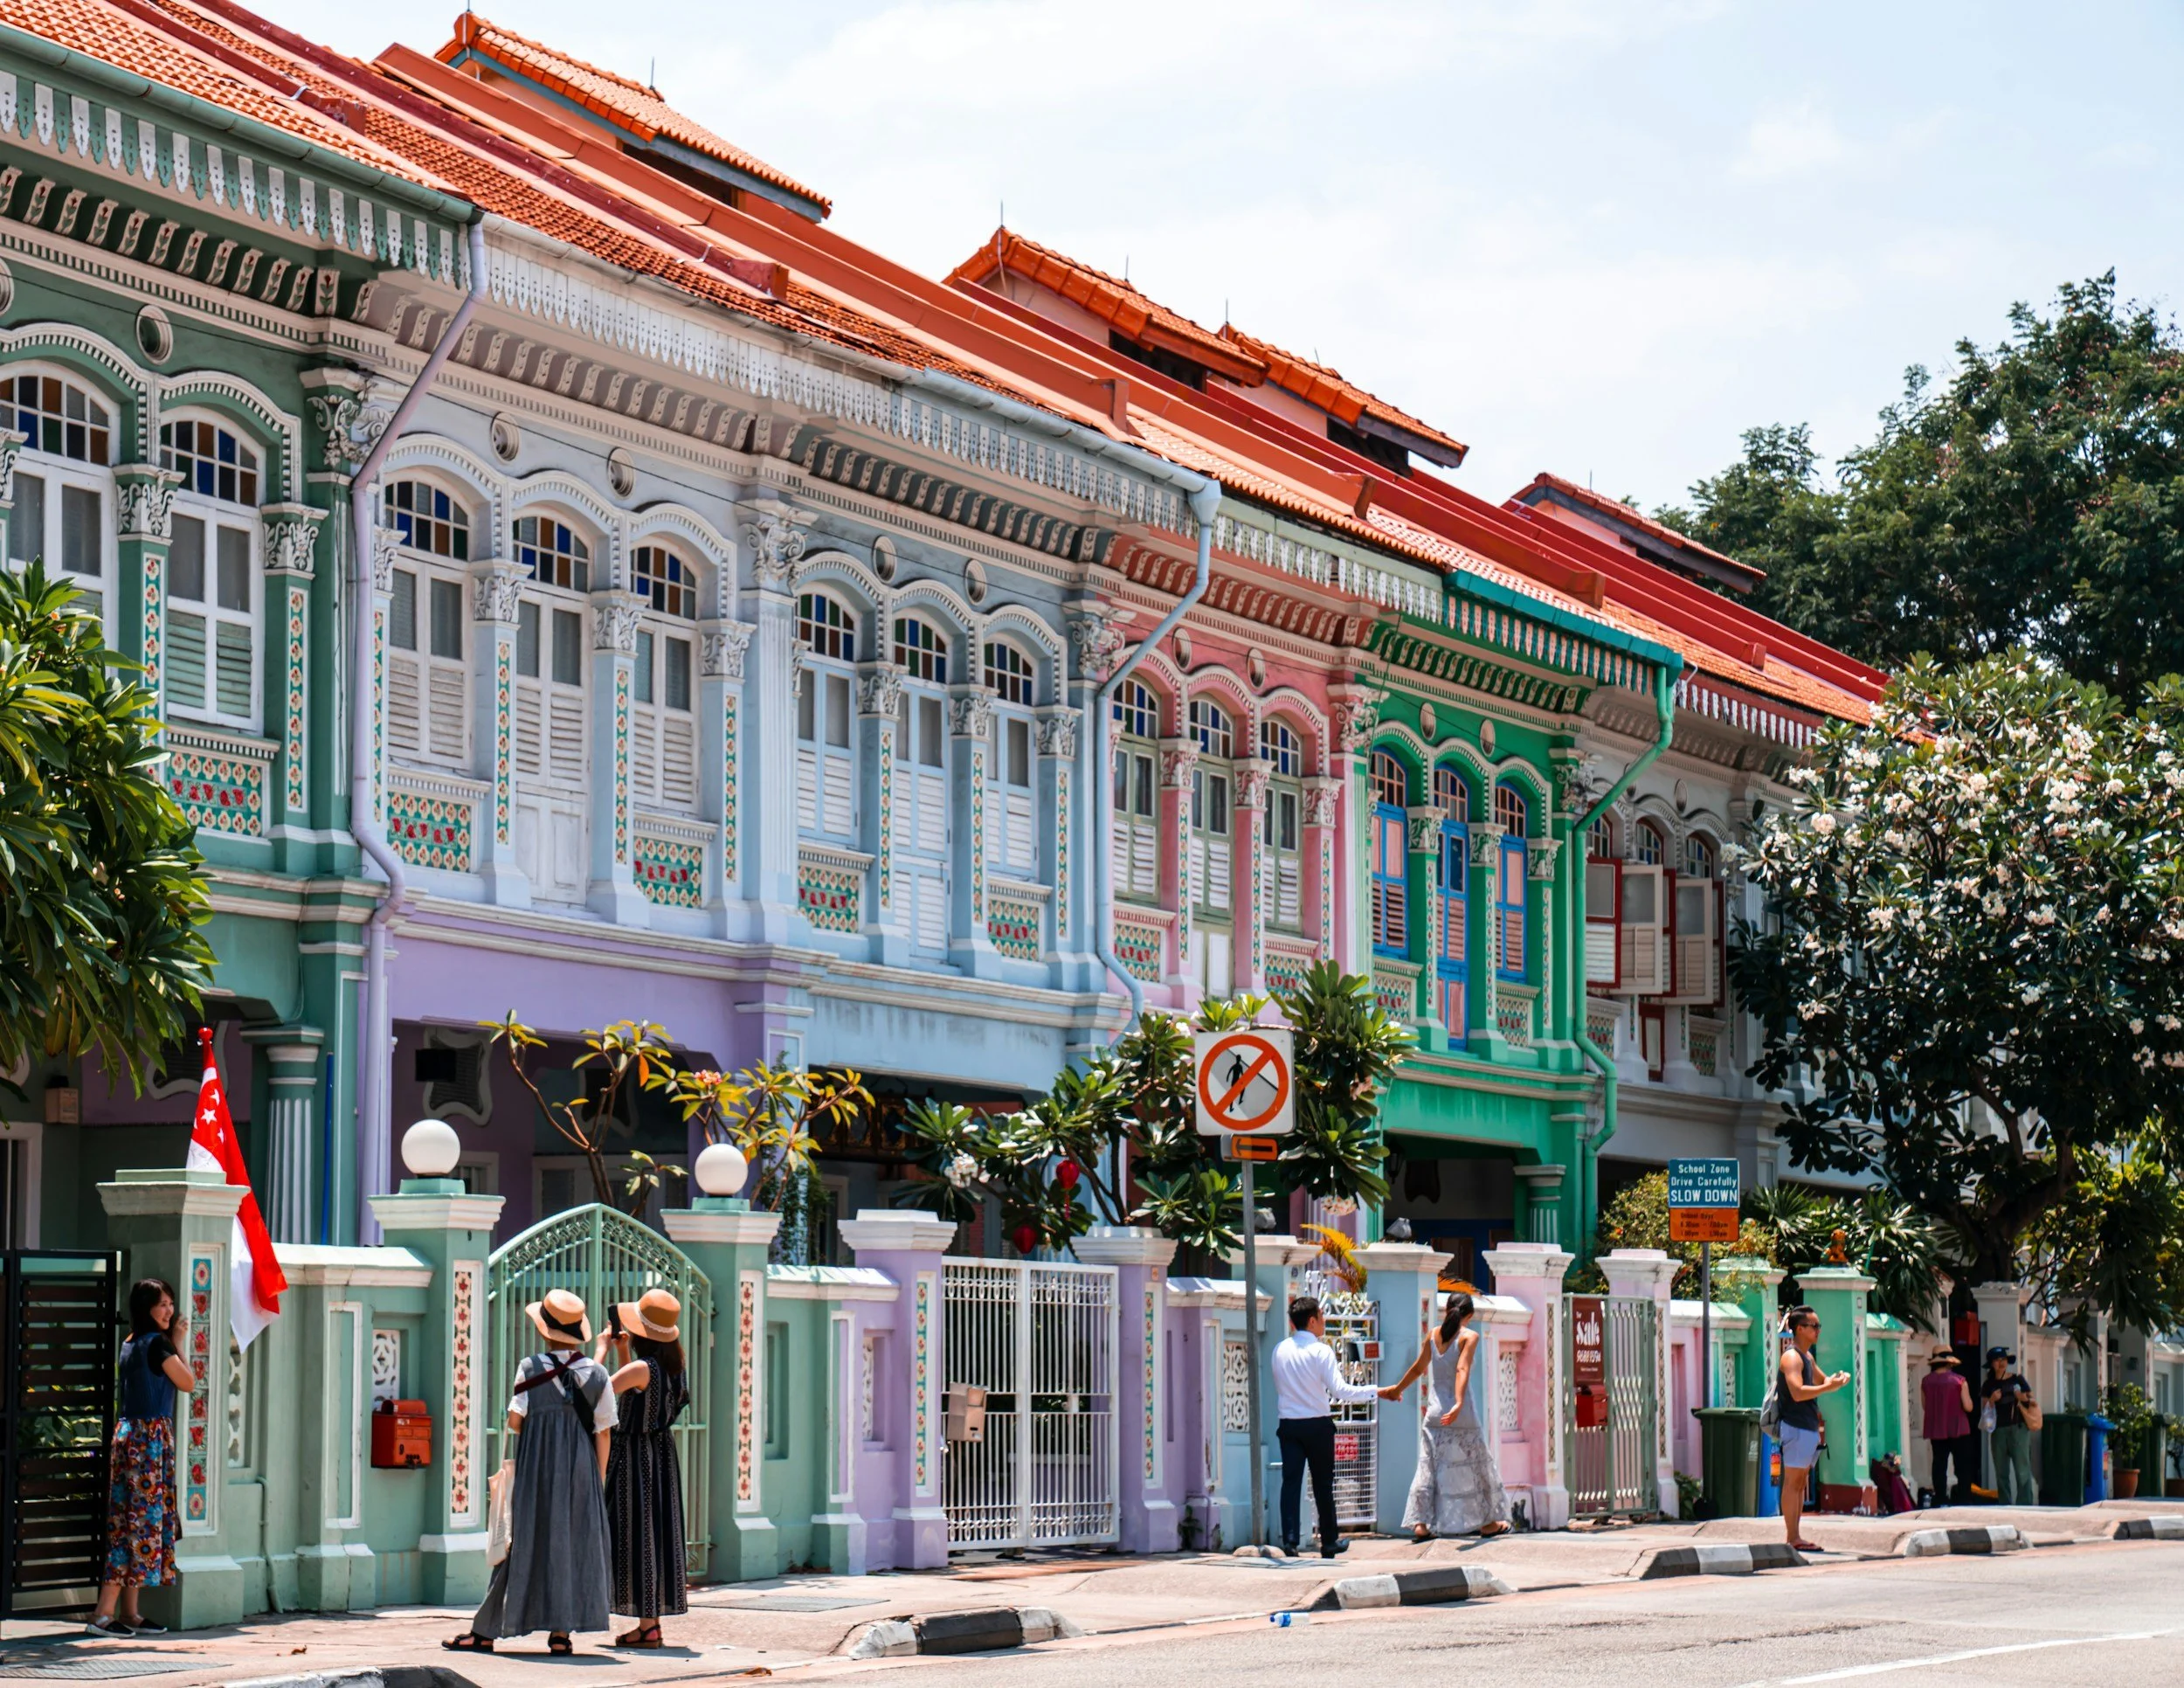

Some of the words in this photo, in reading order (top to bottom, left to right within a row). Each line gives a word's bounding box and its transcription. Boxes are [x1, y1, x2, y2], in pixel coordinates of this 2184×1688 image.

[1678, 1164, 1705, 1173] School
[1711, 1164, 1730, 1173] Zone
[1671, 1177, 1693, 1186] Drive
[1697, 1177, 1737, 1188] Carefully
[1670, 1190, 1701, 1202] SLOW
[1704, 1190, 1738, 1202] DOWN
